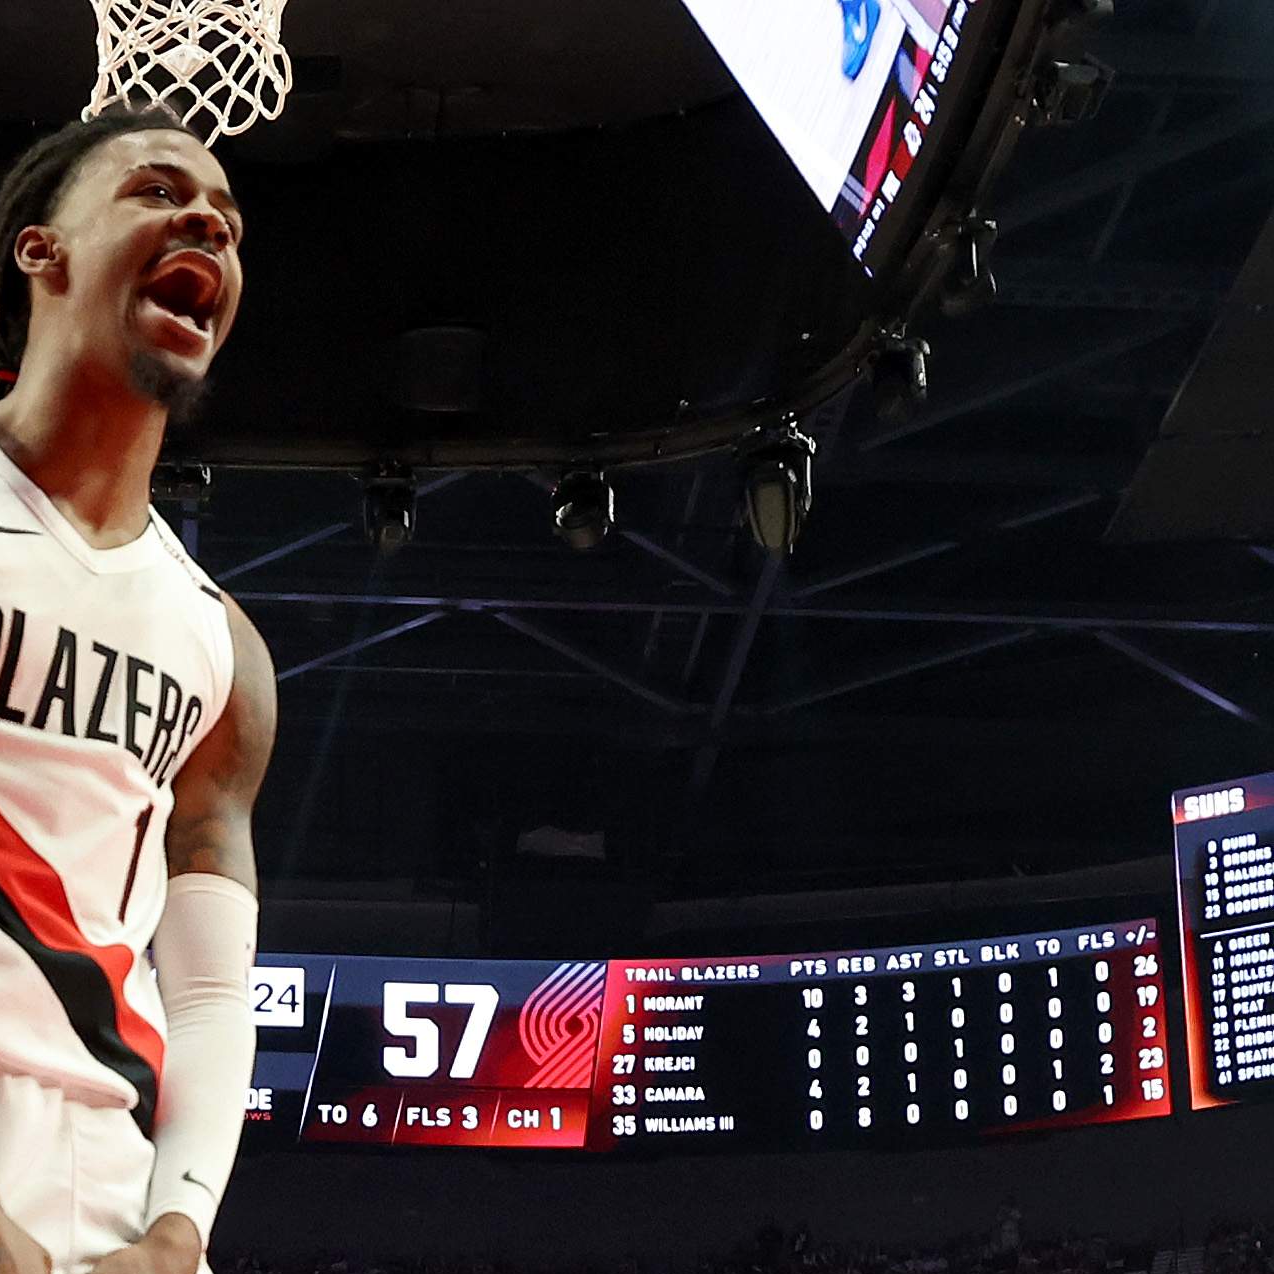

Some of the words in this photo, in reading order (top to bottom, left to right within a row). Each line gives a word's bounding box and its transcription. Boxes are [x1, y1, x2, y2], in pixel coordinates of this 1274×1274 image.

[1184, 787, 1245, 821] SUNS
[1222, 834, 1256, 851] DUNN
[119, 800, 155, 926] 1
[791, 960, 826, 976] PTS
[838, 957, 875, 973] REB
[887, 953, 922, 969] AST
[935, 950, 969, 966] STL
[981, 944, 1019, 961] BLK
[1036, 939, 1059, 955] TO
[1079, 932, 1114, 950] FLS
[1126, 926, 1155, 945] +/-
[1229, 933, 1269, 951] GREEN
[625, 968, 675, 981] TRAIL
[682, 965, 759, 980] BLAZERS
[803, 989, 822, 1008] 10
[855, 986, 867, 1005] 3
[903, 982, 915, 1001] 3
[952, 978, 961, 997] 1
[999, 973, 1011, 992] 0
[1049, 968, 1057, 987] 1
[1096, 961, 1108, 981] 0
[1134, 955, 1157, 976] 26
[252, 982, 301, 1013] 24
[626, 995, 634, 1013] 1
[644, 996, 703, 1011] MORANT
[1234, 999, 1264, 1015] PEAT
[808, 1019, 820, 1037] 4
[856, 1016, 868, 1035] 2
[905, 1012, 913, 1031] 1
[952, 1008, 964, 1027] 0
[1000, 1003, 1012, 1023] 0
[1049, 998, 1061, 1017] 0
[1097, 992, 1110, 1011] 0
[1137, 986, 1157, 1006] 19
[384, 983, 499, 1078] 57
[623, 1025, 635, 1043] 5
[645, 1026, 703, 1041] HOLIDAY
[613, 1055, 635, 1074] 27
[645, 1057, 695, 1071] KREJCI
[613, 1085, 635, 1104] 33
[645, 1087, 705, 1101] CAMARA
[318, 1105, 347, 1123] TO
[363, 1104, 377, 1126] 6
[407, 1108, 450, 1126] FLS
[463, 1106, 477, 1129] 3
[508, 1110, 539, 1128] CH
[551, 1108, 560, 1129] 1
[613, 1116, 636, 1135] 35
[645, 1117, 715, 1131] WILLIAMS
[720, 1116, 733, 1130] III
